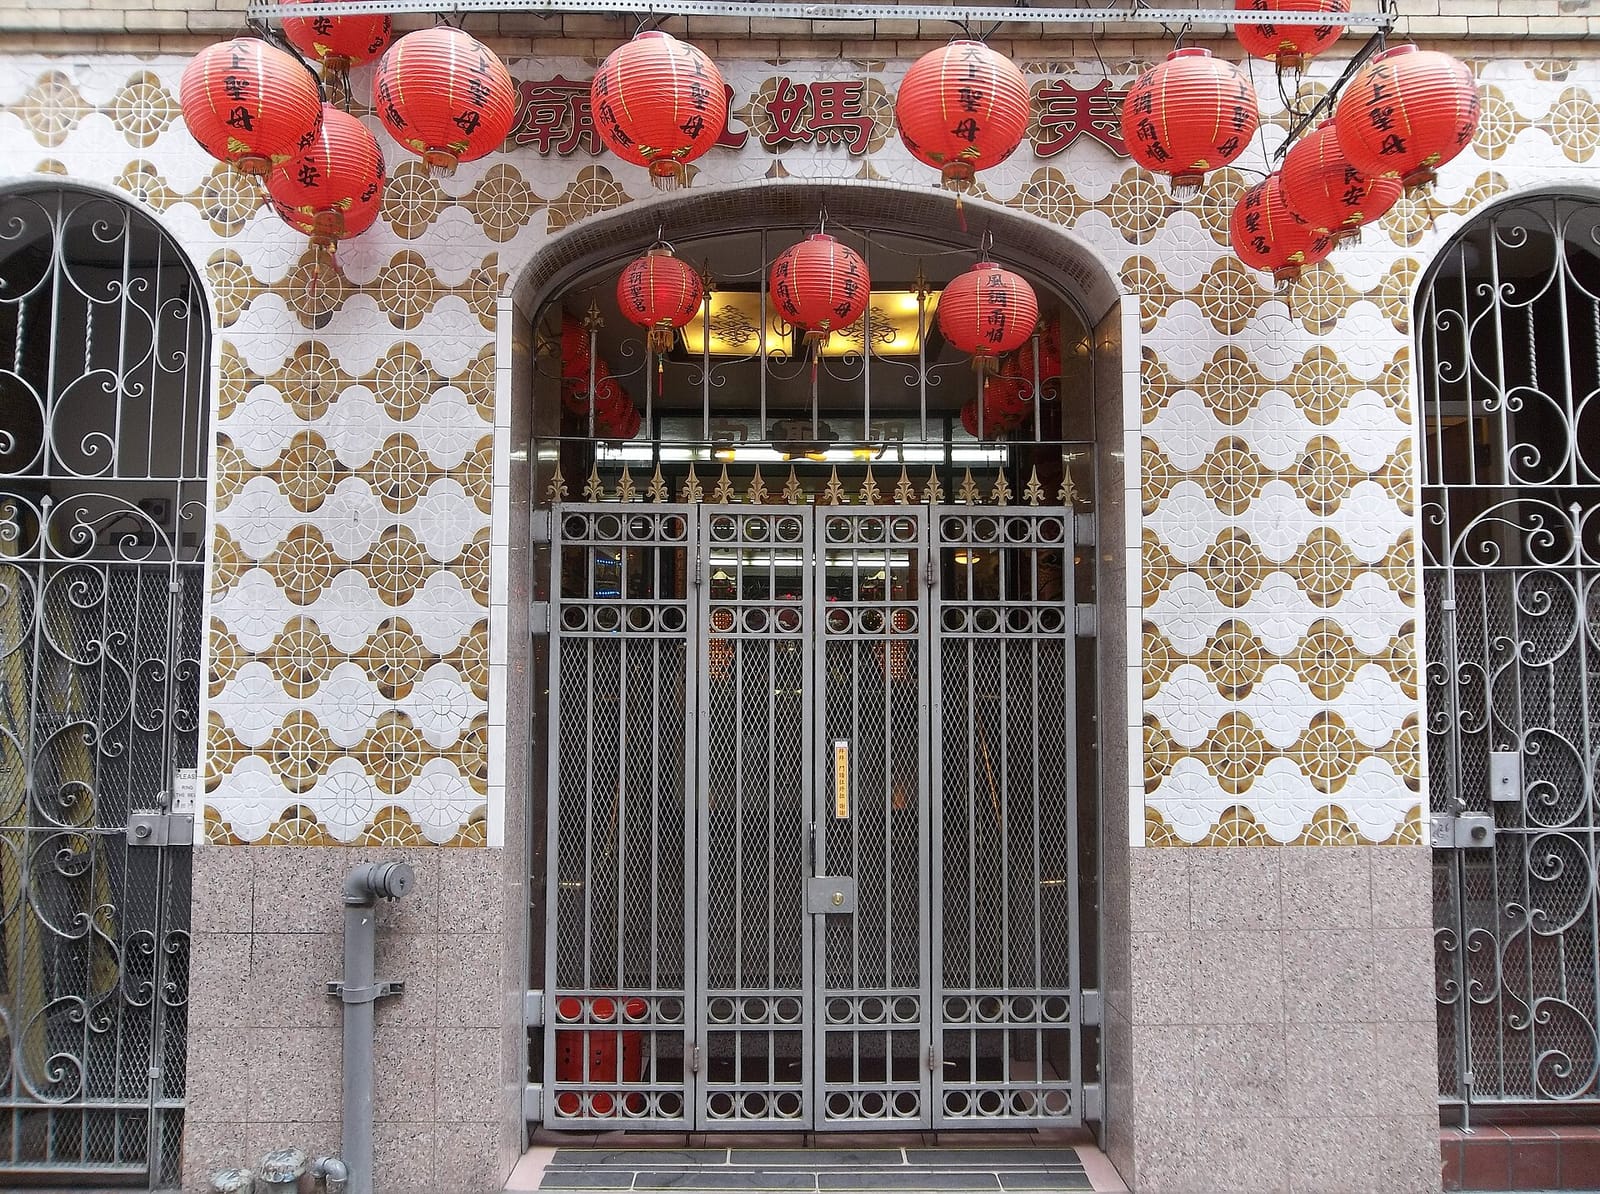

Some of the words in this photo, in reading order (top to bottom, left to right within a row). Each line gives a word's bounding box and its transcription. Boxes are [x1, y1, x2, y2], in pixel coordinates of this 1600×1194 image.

[223, 42, 255, 131] 天上聖母
[453, 42, 495, 135] 天上聖母
[679, 43, 711, 140] 天上聖母
[950, 48, 983, 141] 天上聖母
[1134, 69, 1174, 164] 風調雨順
[1364, 65, 1407, 155] 天上聖母
[833, 247, 862, 318] 天上聖母
[985, 273, 1008, 343] 風調雨順
